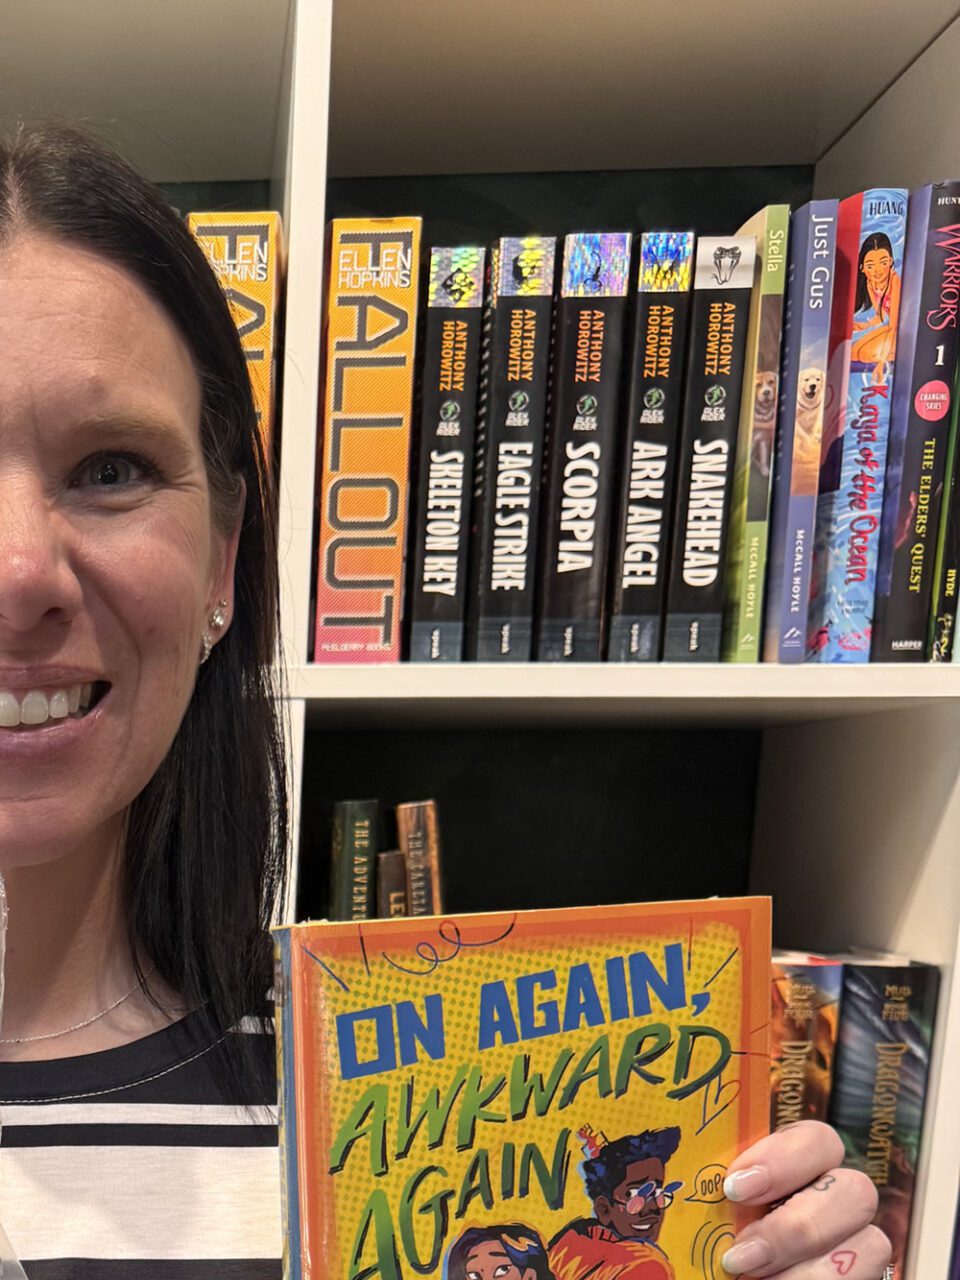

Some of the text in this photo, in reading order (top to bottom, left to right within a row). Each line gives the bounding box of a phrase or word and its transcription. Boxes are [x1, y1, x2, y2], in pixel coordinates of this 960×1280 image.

[869, 201, 904, 216] HUANG
[337, 270, 411, 289] HOPKINS
[338, 248, 412, 273] ELLEN
[767, 230, 784, 272] Stella
[809, 214, 834, 309] Just Gus
[927, 223, 960, 331] WARRIORS
[439, 320, 455, 391] HOROWITZ
[452, 320, 468, 392] ANTHONY
[507, 309, 524, 382] HOROWITZ
[520, 309, 536, 382] ANTHONY
[574, 310, 592, 383] HOROWITZ
[588, 310, 605, 383] ANTHONY
[643, 305, 661, 378] HOROWITZ
[657, 305, 674, 378] ANTHONY
[704, 303, 722, 376] HOROWITZ
[719, 302, 736, 376] ANTHONY
[934, 345, 945, 366] 1
[318, 230, 414, 648] FALLOUT
[850, 385, 889, 442] Kaya
[422, 450, 464, 596] SKELETON KEY
[491, 442, 533, 590] EAGLE STRIKE
[557, 441, 601, 573] SCORPIA
[622, 441, 667, 588] ARK ANGEL
[683, 439, 729, 587] SNAKEHEAD
[908, 438, 936, 593] THE ELDERS' QUEST
[844, 515, 880, 585] Ocean
[945, 569, 956, 597] HYDE
[745, 583, 757, 618] HOYLE
[790, 578, 802, 613] HOYLE
[354, 820, 370, 848] THE
[336, 943, 711, 1081] ON AGAIN,
[328, 1023, 731, 1177] AWKWARD
[700, 1173, 725, 1197] OOP
